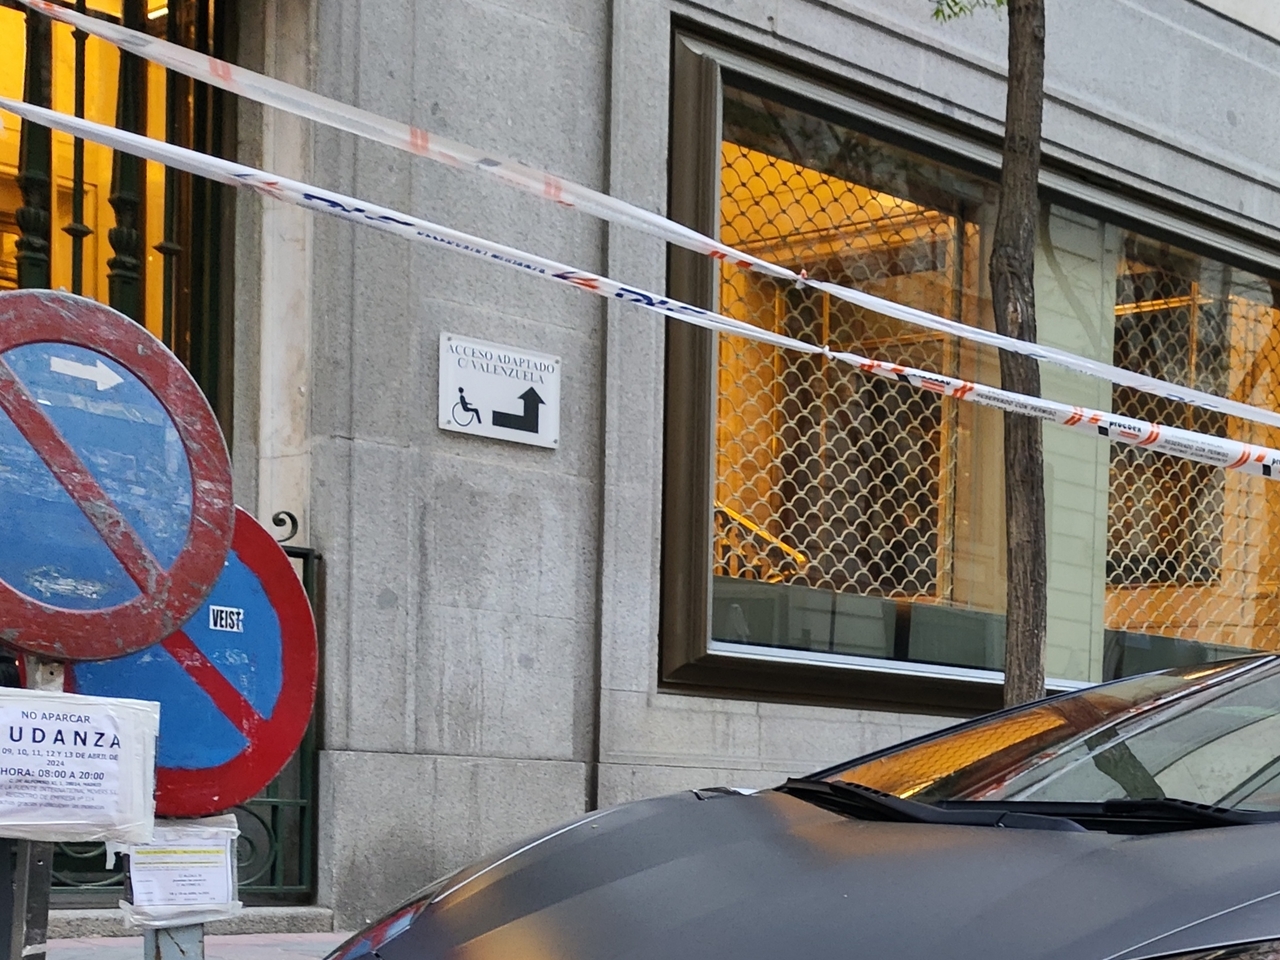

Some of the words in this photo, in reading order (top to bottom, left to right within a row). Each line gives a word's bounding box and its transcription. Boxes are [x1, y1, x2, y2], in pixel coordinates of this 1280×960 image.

[448, 344, 493, 361] ACCESO
[496, 354, 555, 374] ADAPTADO
[471, 360, 545, 384] VALENZUELA
[21, 711, 37, 720] NO
[41, 712, 91, 724] APARCAR
[46, 759, 65, 767] 2024
[1, 767, 35, 777] HORA:
[38, 769, 66, 778] 08:00
[69, 771, 75, 779] A
[79, 771, 104, 780] 20:00
